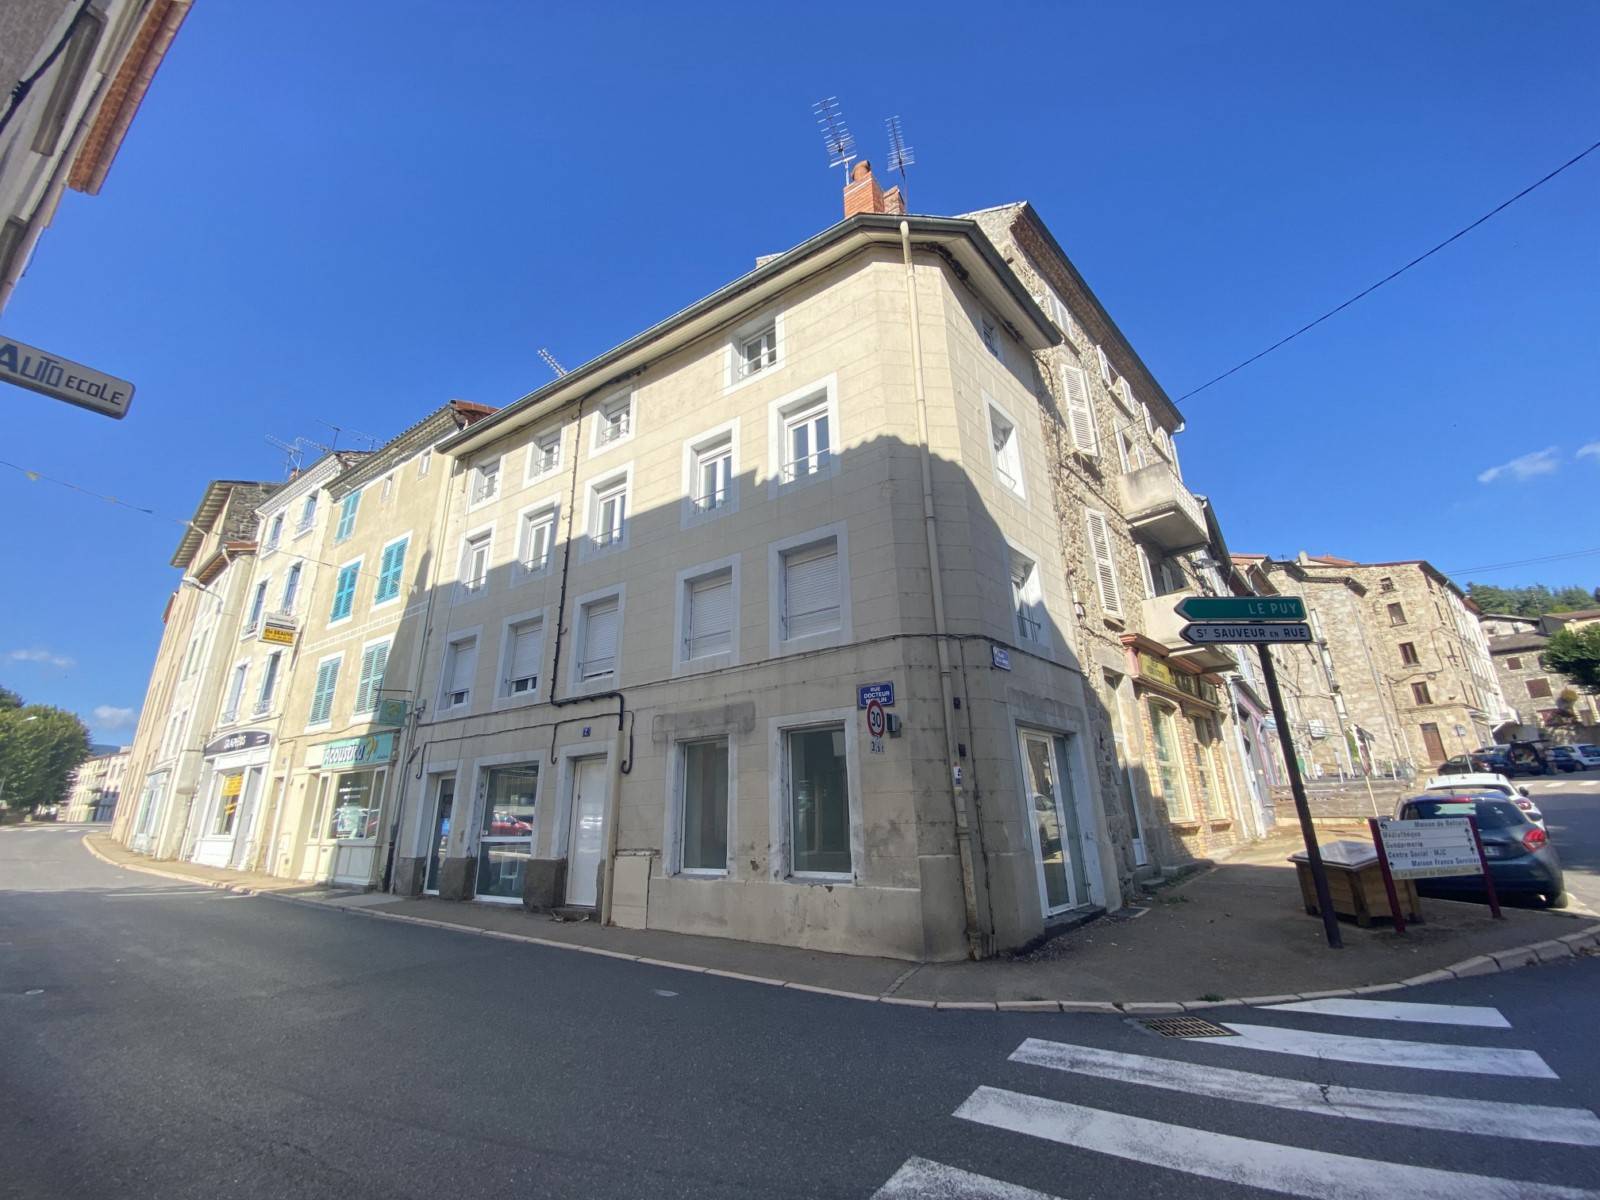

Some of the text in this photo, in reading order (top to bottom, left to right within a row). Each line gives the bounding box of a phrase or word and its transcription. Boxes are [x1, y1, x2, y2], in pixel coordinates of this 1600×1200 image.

[65, 375, 125, 406] ECOLE
[1248, 603, 1296, 614] LE PUY
[1215, 628, 1266, 638] SAUVEUR
[1285, 628, 1307, 638] RUE
[863, 690, 890, 699] DOCTEUR
[871, 711, 881, 727] 30
